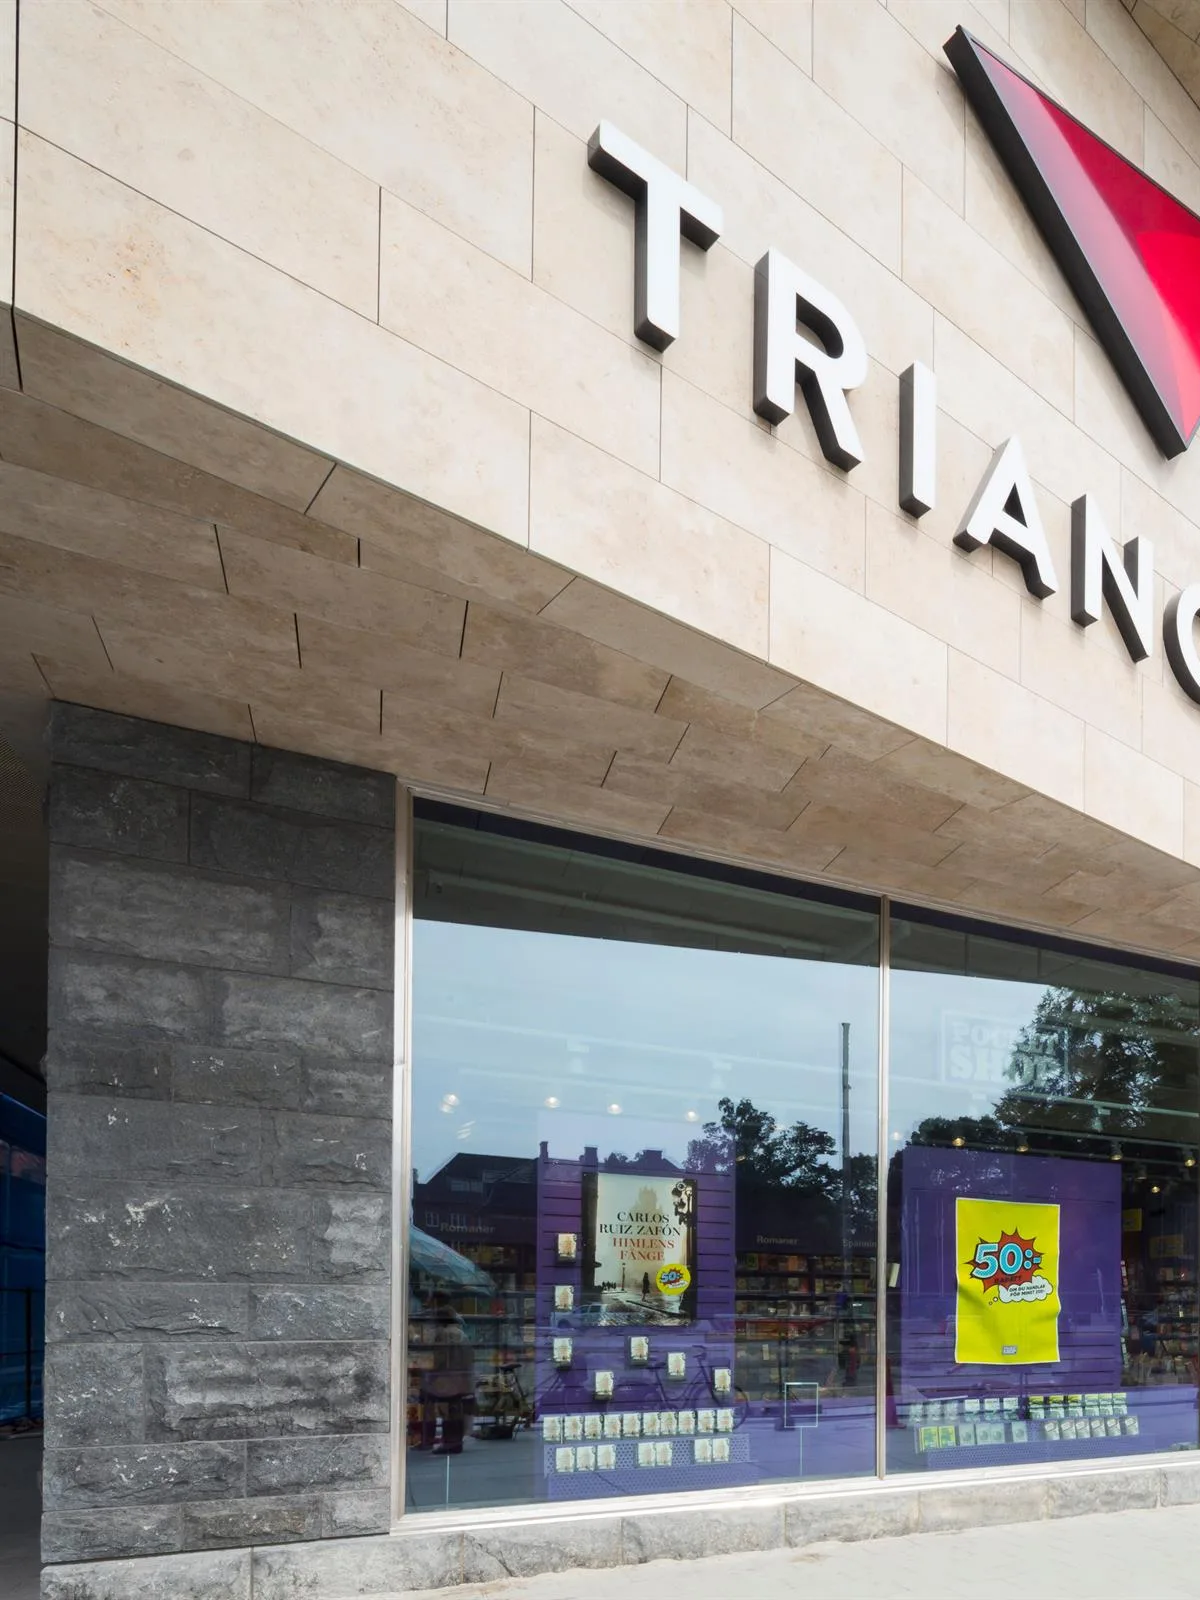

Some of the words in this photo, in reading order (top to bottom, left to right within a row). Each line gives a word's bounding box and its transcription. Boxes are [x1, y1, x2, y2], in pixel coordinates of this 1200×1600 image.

[617, 1211, 670, 1223] CARLOS
[440, 1222, 496, 1234] Romaner
[600, 1224, 633, 1235] RUIZ
[637, 1224, 681, 1237] ZAFÓN
[613, 1237, 675, 1249] HIMLENS
[756, 1235, 799, 1246] Romaner
[971, 1243, 1042, 1279] 50:-
